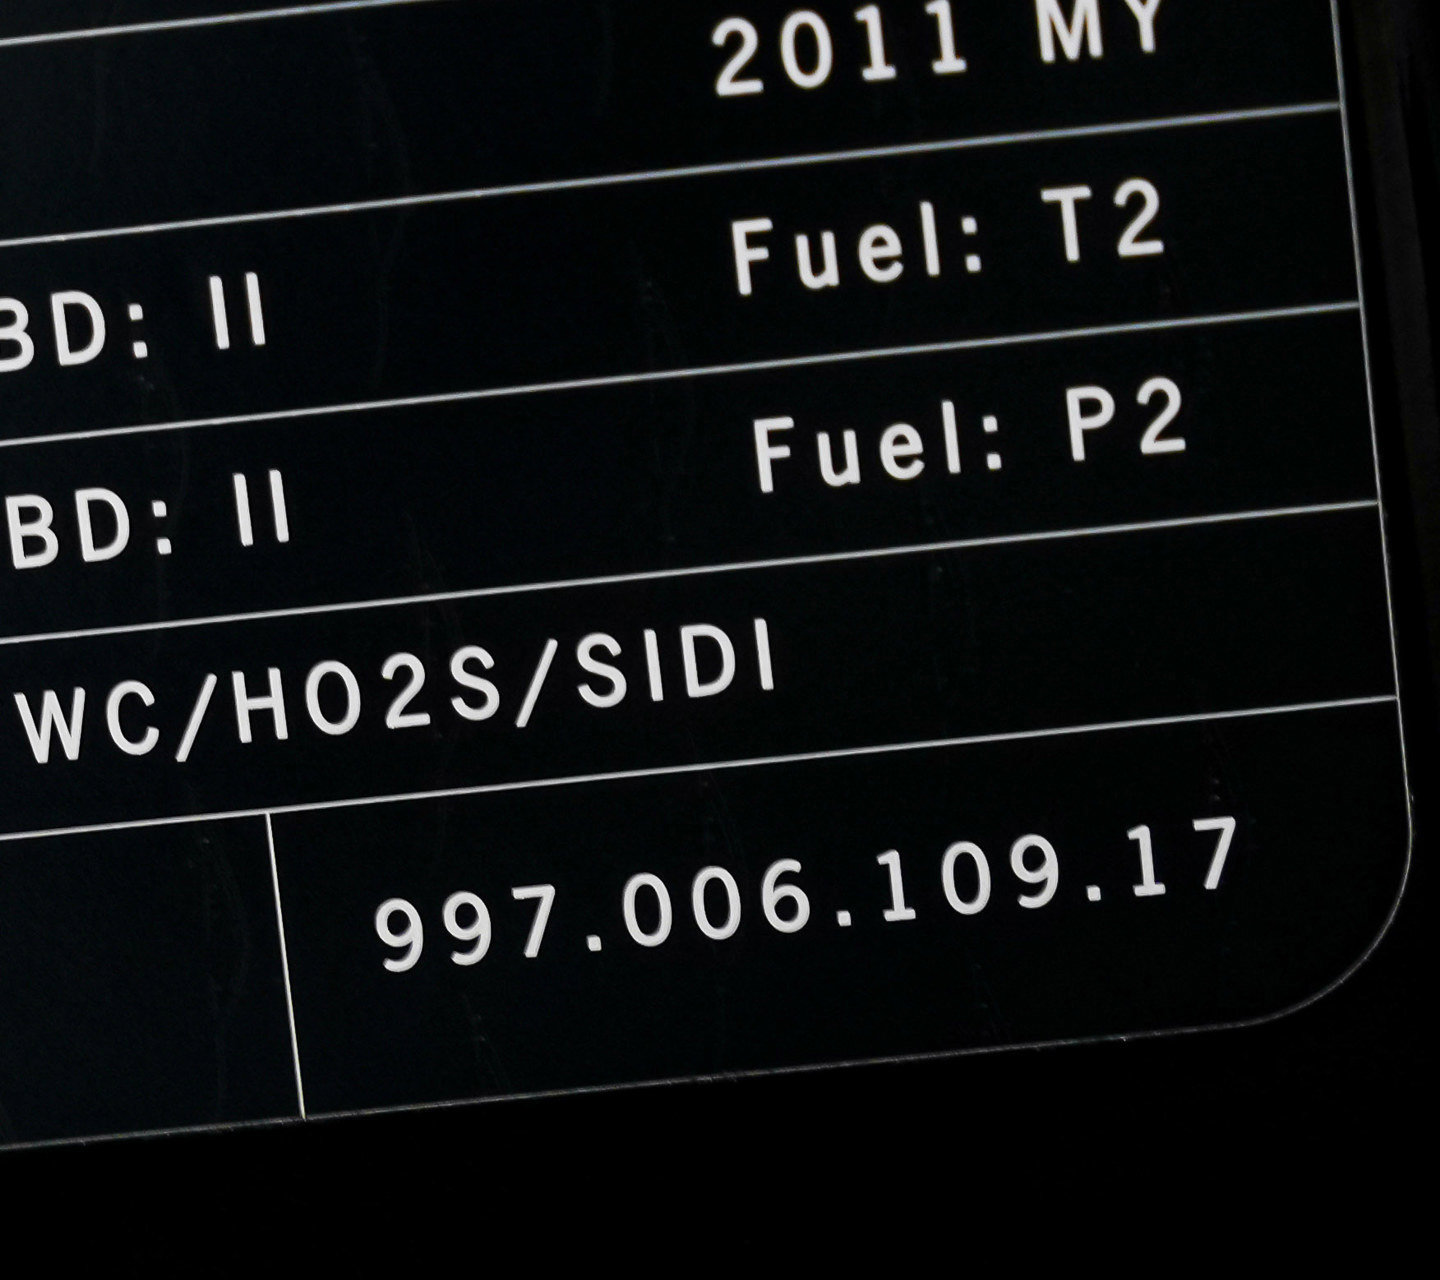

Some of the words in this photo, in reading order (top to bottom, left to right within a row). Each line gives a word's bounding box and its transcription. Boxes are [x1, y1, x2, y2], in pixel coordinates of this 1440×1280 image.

[729, 199, 983, 298] Fuel:
[1039, 176, 1166, 264] T2
[207, 269, 268, 352] II
[751, 398, 1004, 495] Fuel:
[1064, 375, 1188, 464] P2
[231, 467, 292, 549] II
[373, 814, 1238, 975] 997.006.109.17
